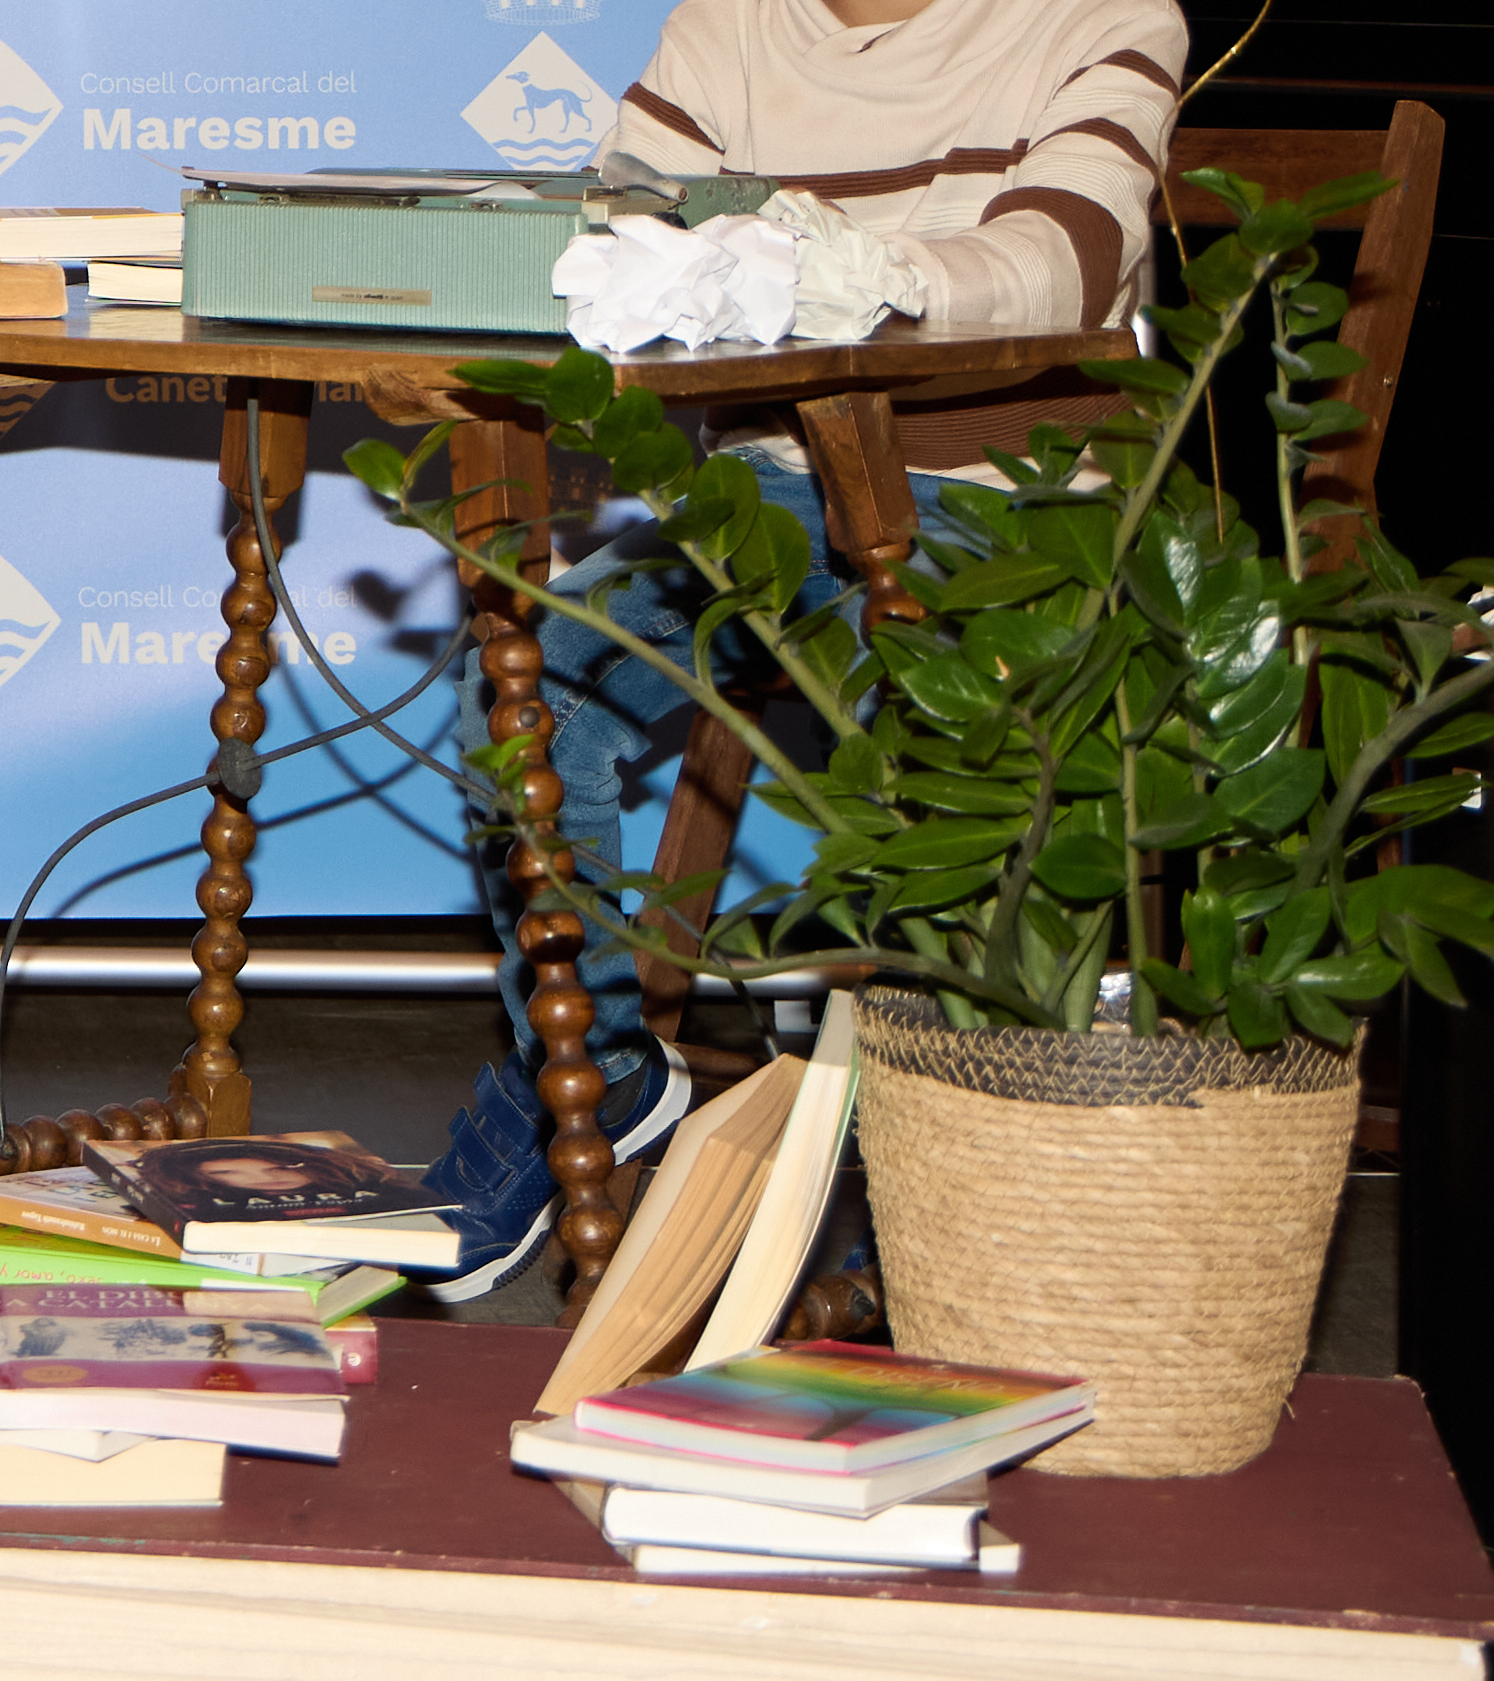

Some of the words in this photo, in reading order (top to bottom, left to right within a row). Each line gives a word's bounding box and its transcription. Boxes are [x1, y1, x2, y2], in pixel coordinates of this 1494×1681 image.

[78, 586, 174, 608] Consell
[82, 623, 355, 665] Mareme
[212, 1190, 379, 1206] LAURA
[14, 1269, 54, 1282] amor
